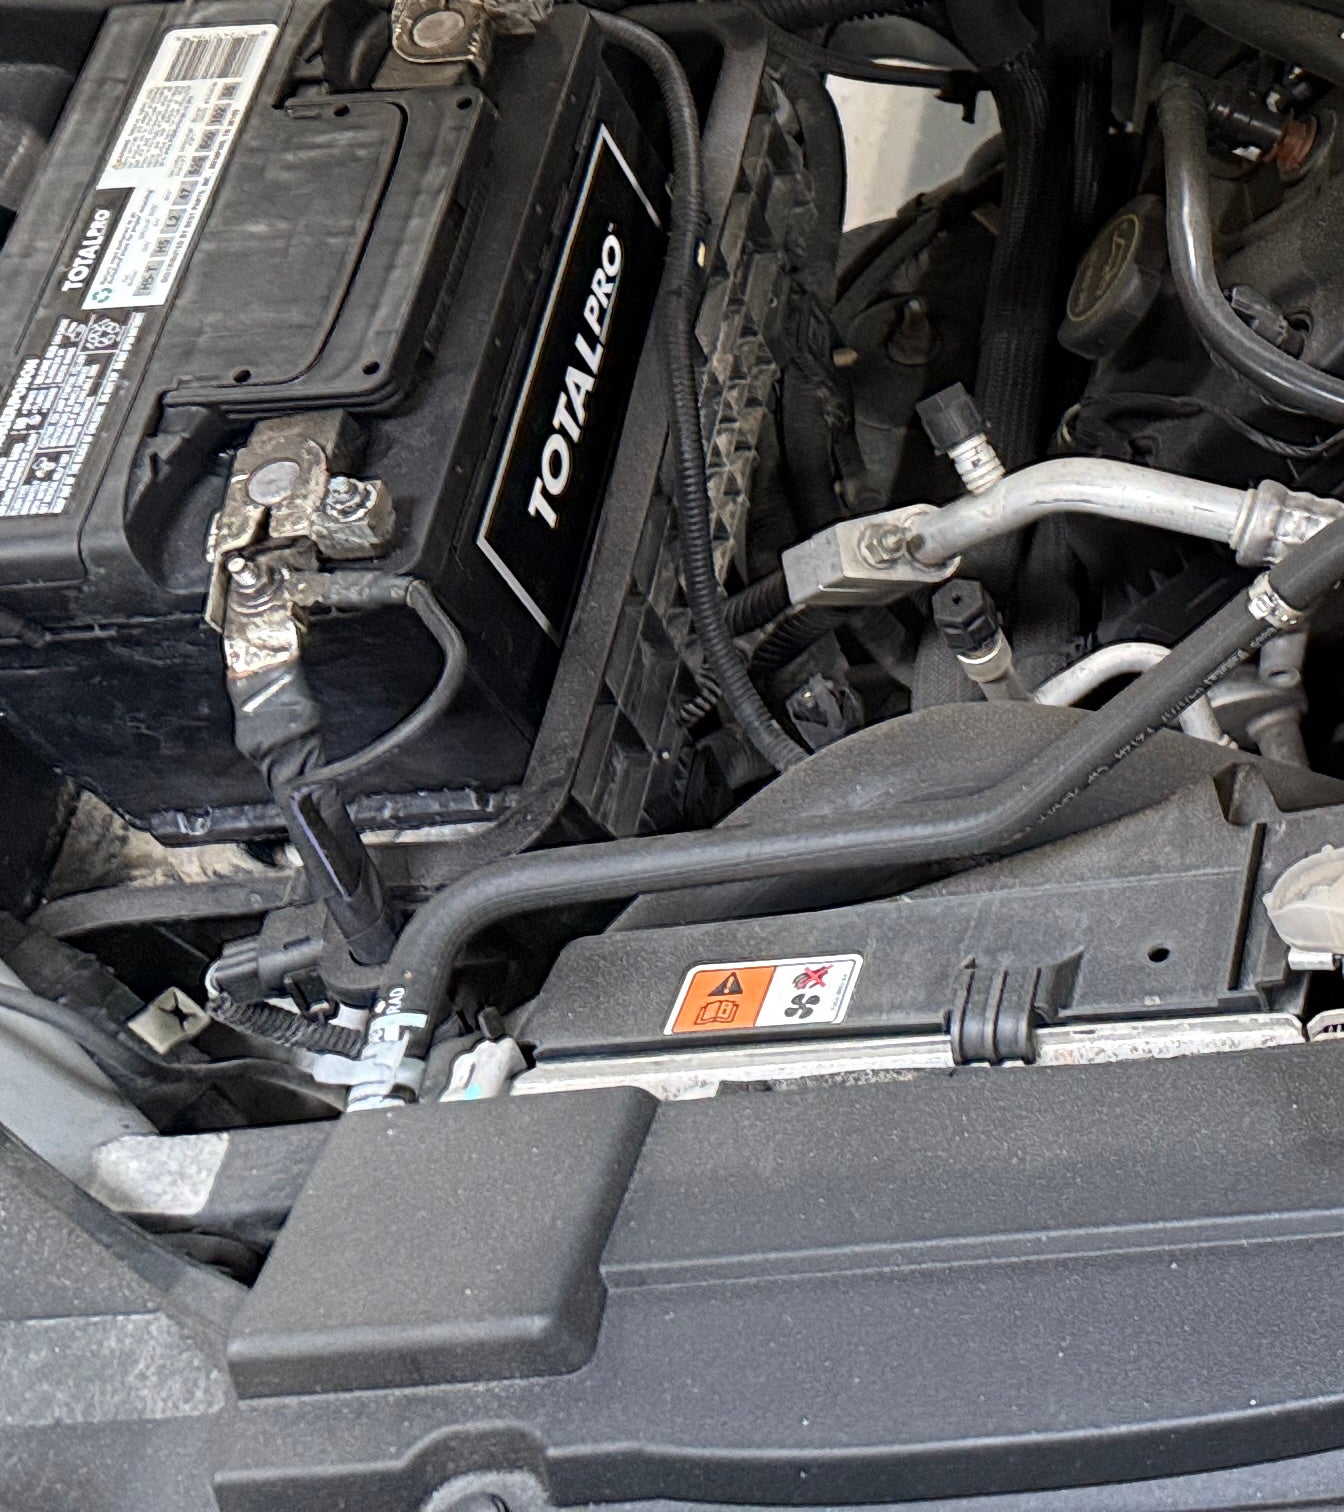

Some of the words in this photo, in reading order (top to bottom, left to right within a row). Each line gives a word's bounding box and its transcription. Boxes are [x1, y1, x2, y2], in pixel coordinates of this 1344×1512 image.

[61, 208, 111, 294] TOTALPRO
[527, 231, 626, 530] TOTALPRO
[385, 987, 406, 1015] RAD
